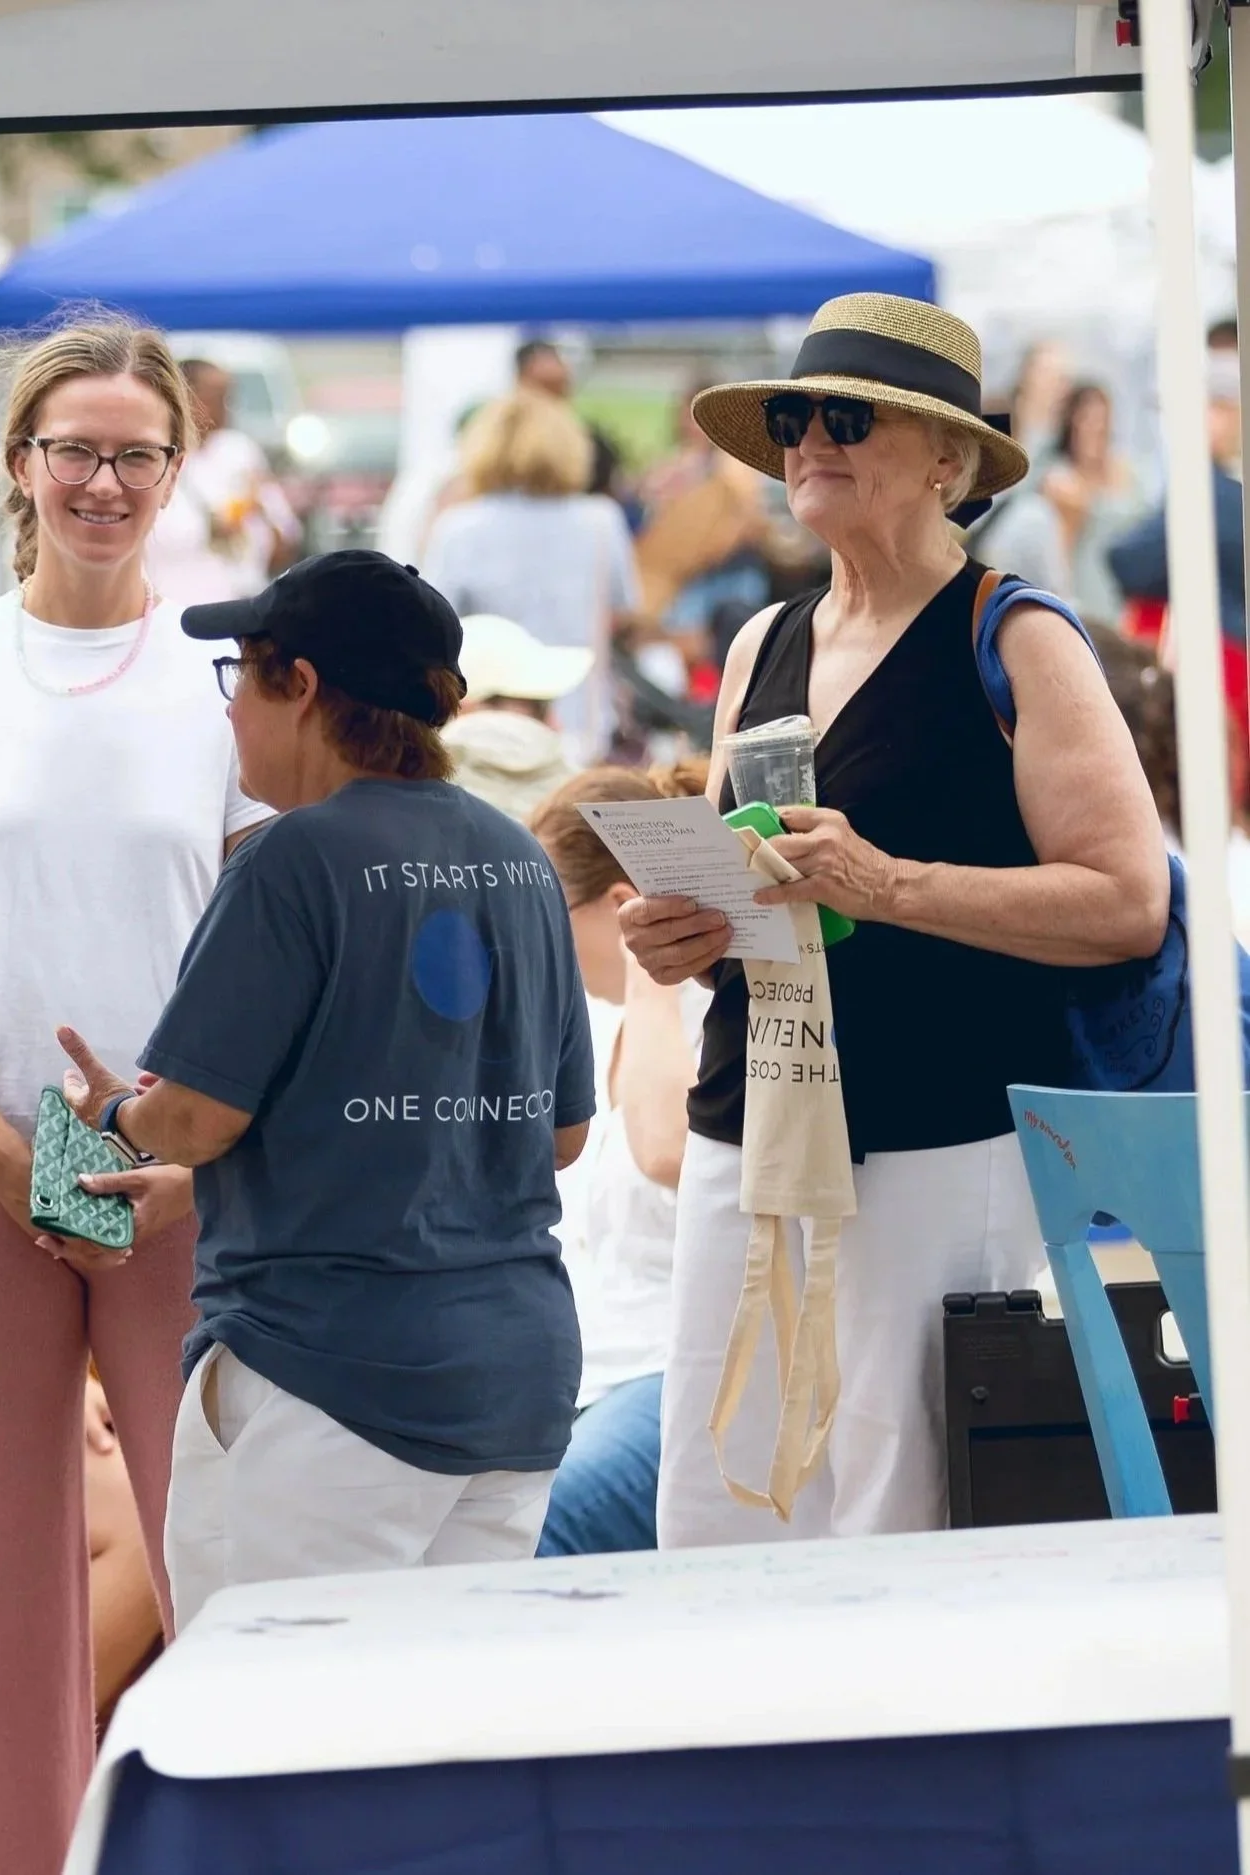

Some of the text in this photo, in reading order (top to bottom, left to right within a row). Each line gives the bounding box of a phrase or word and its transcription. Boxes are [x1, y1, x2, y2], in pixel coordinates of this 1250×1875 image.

[602, 820, 674, 831] CONNECTION
[620, 829, 662, 838] CLOSER
[662, 827, 695, 835] THAN
[613, 837, 674, 847] YOU THINK
[364, 861, 554, 892] IT STARTS WITH
[807, 942, 825, 954] TS
[750, 981, 813, 1003] PROJEC
[747, 1059, 839, 1083] THE COS
[344, 1095, 420, 1122] ONE
